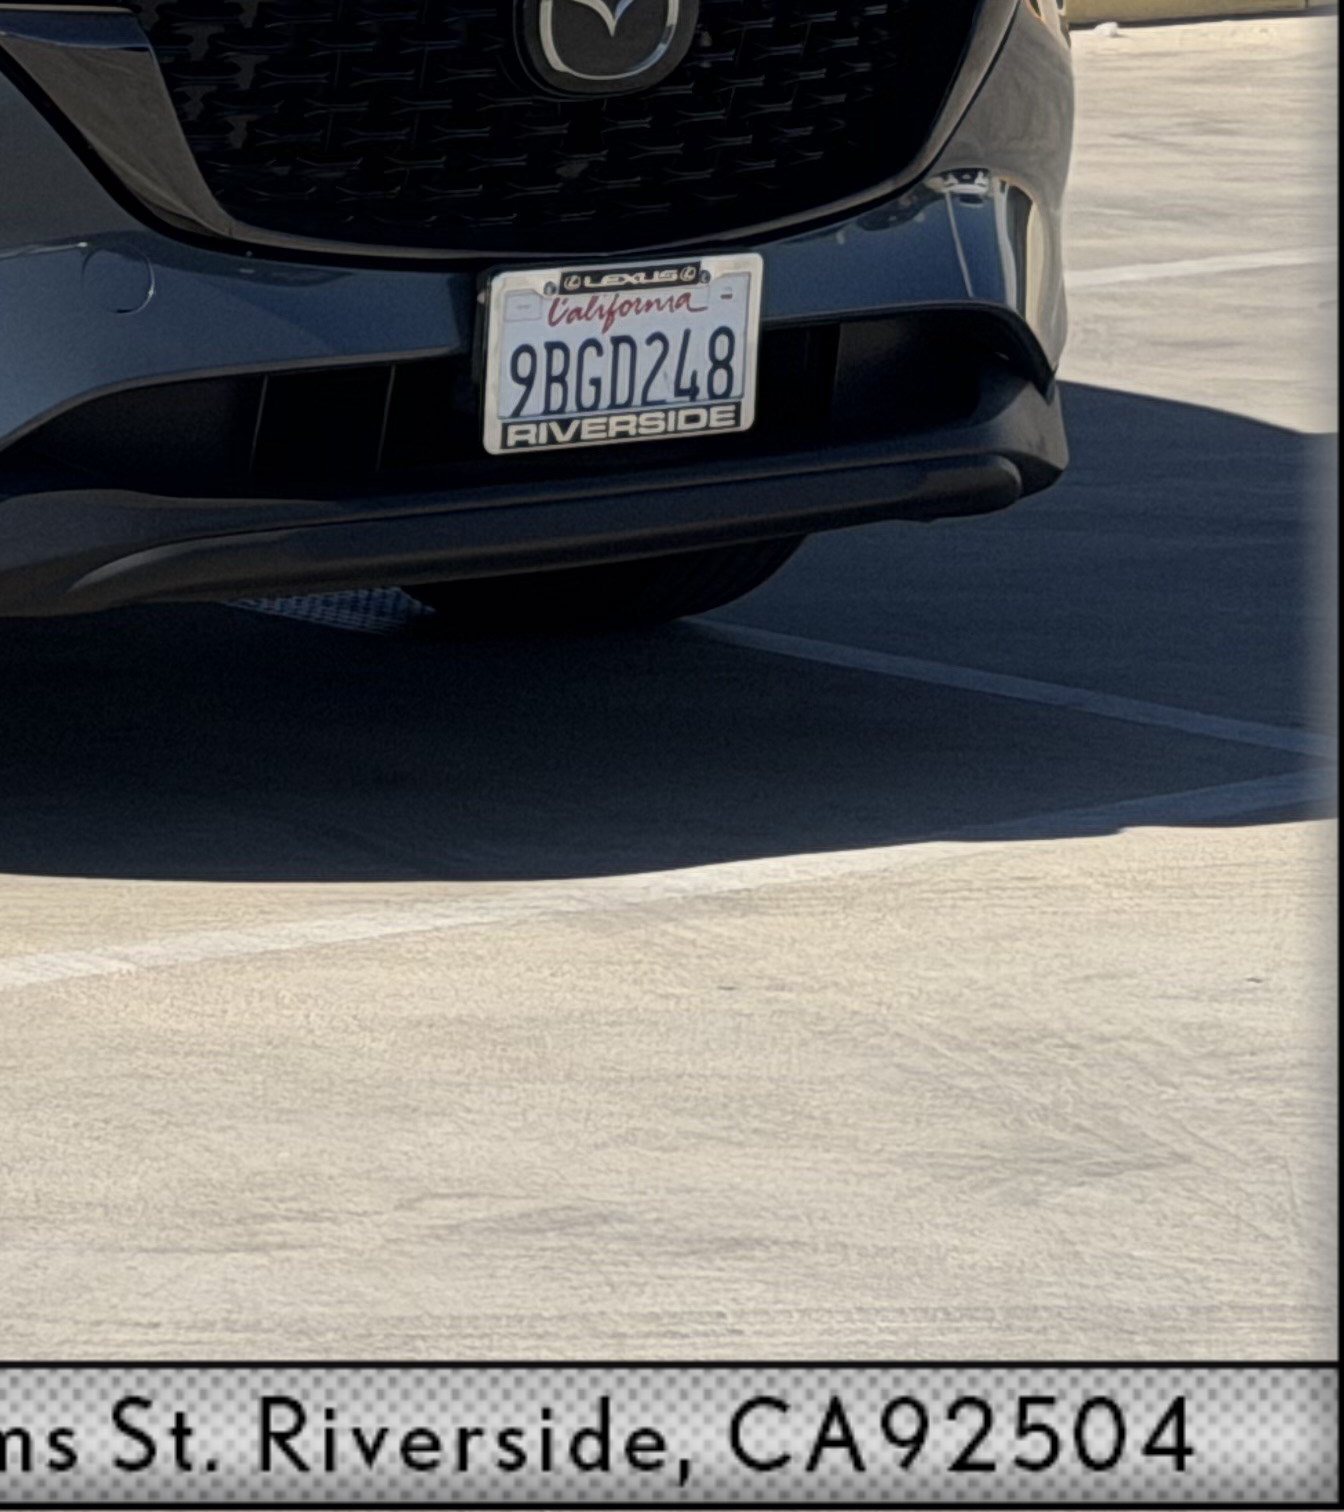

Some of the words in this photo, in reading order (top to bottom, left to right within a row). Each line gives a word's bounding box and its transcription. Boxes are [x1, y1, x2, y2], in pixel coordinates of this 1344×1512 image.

[583, 269, 679, 289] LEXUS
[547, 291, 709, 334] California
[509, 325, 736, 419] 9BGD248
[505, 403, 738, 447] RIVERSIDE
